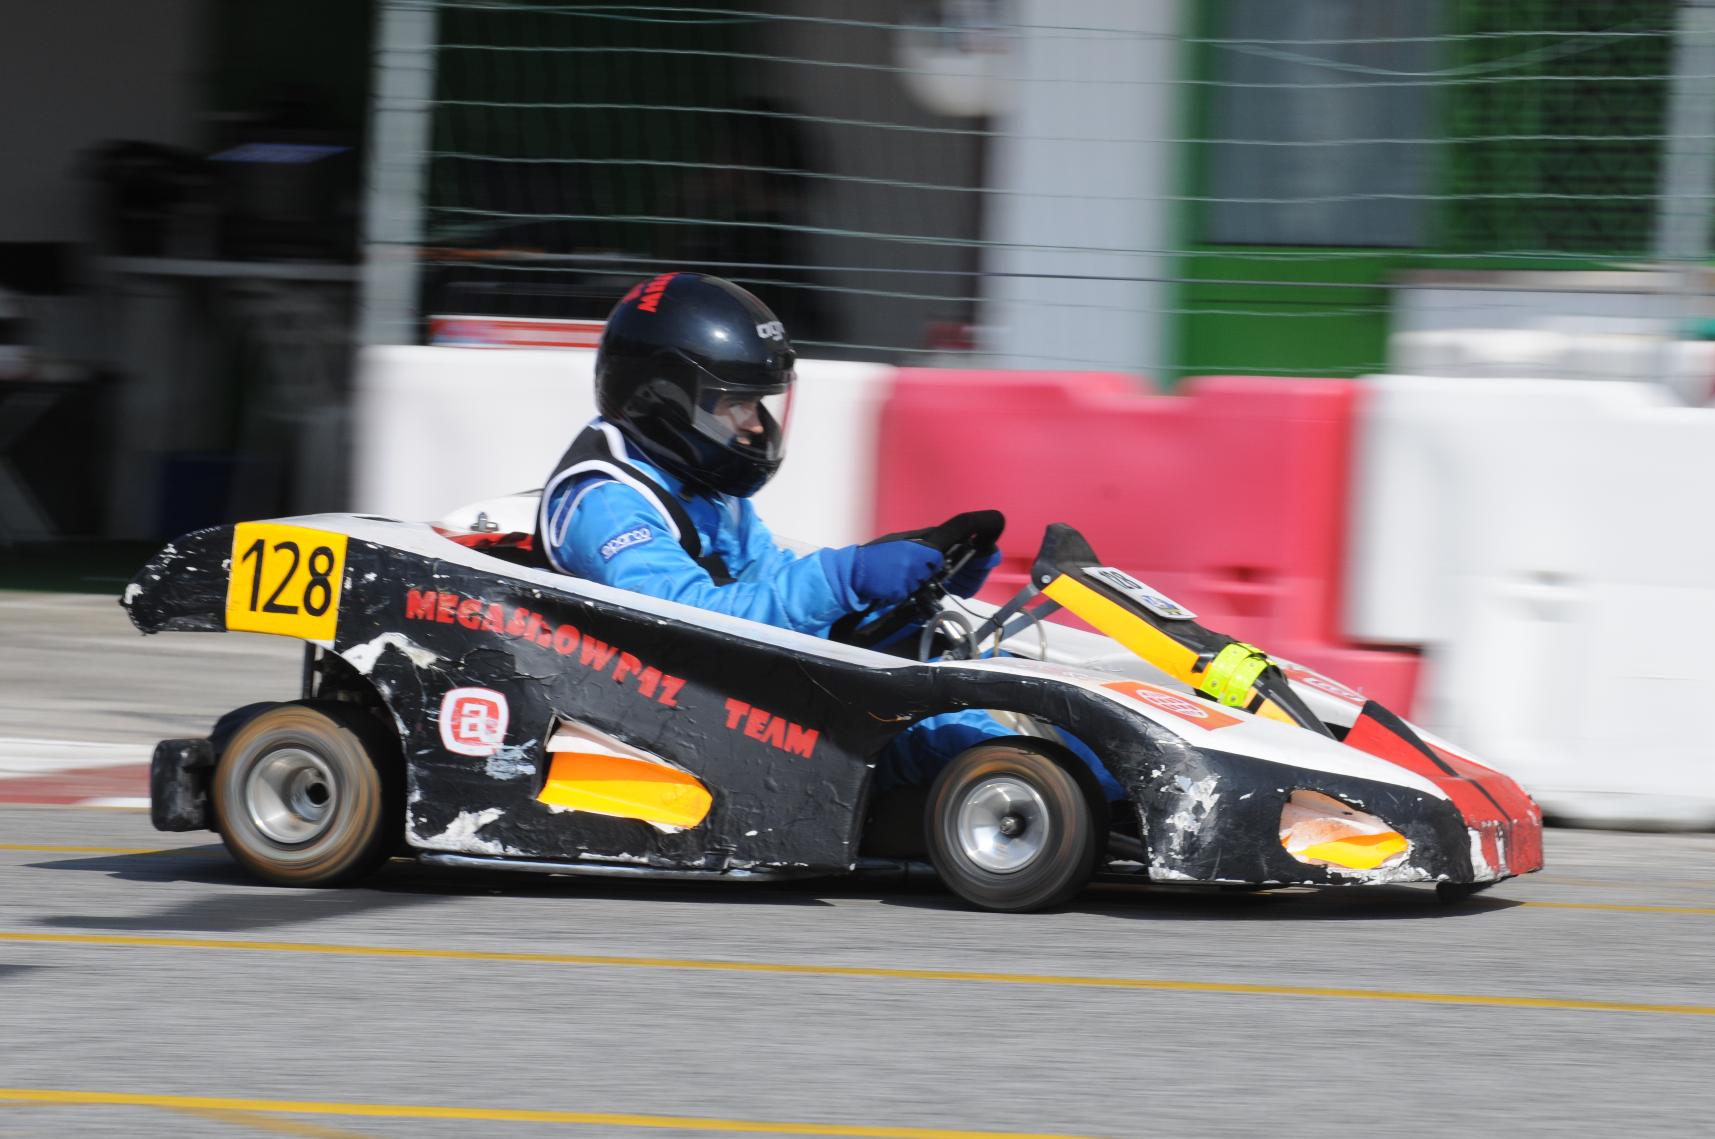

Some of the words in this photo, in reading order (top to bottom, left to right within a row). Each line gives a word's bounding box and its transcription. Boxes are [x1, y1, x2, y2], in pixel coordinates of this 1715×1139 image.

[601, 527, 652, 560] sparco
[241, 538, 335, 617] 128
[724, 697, 820, 759] TEAM
